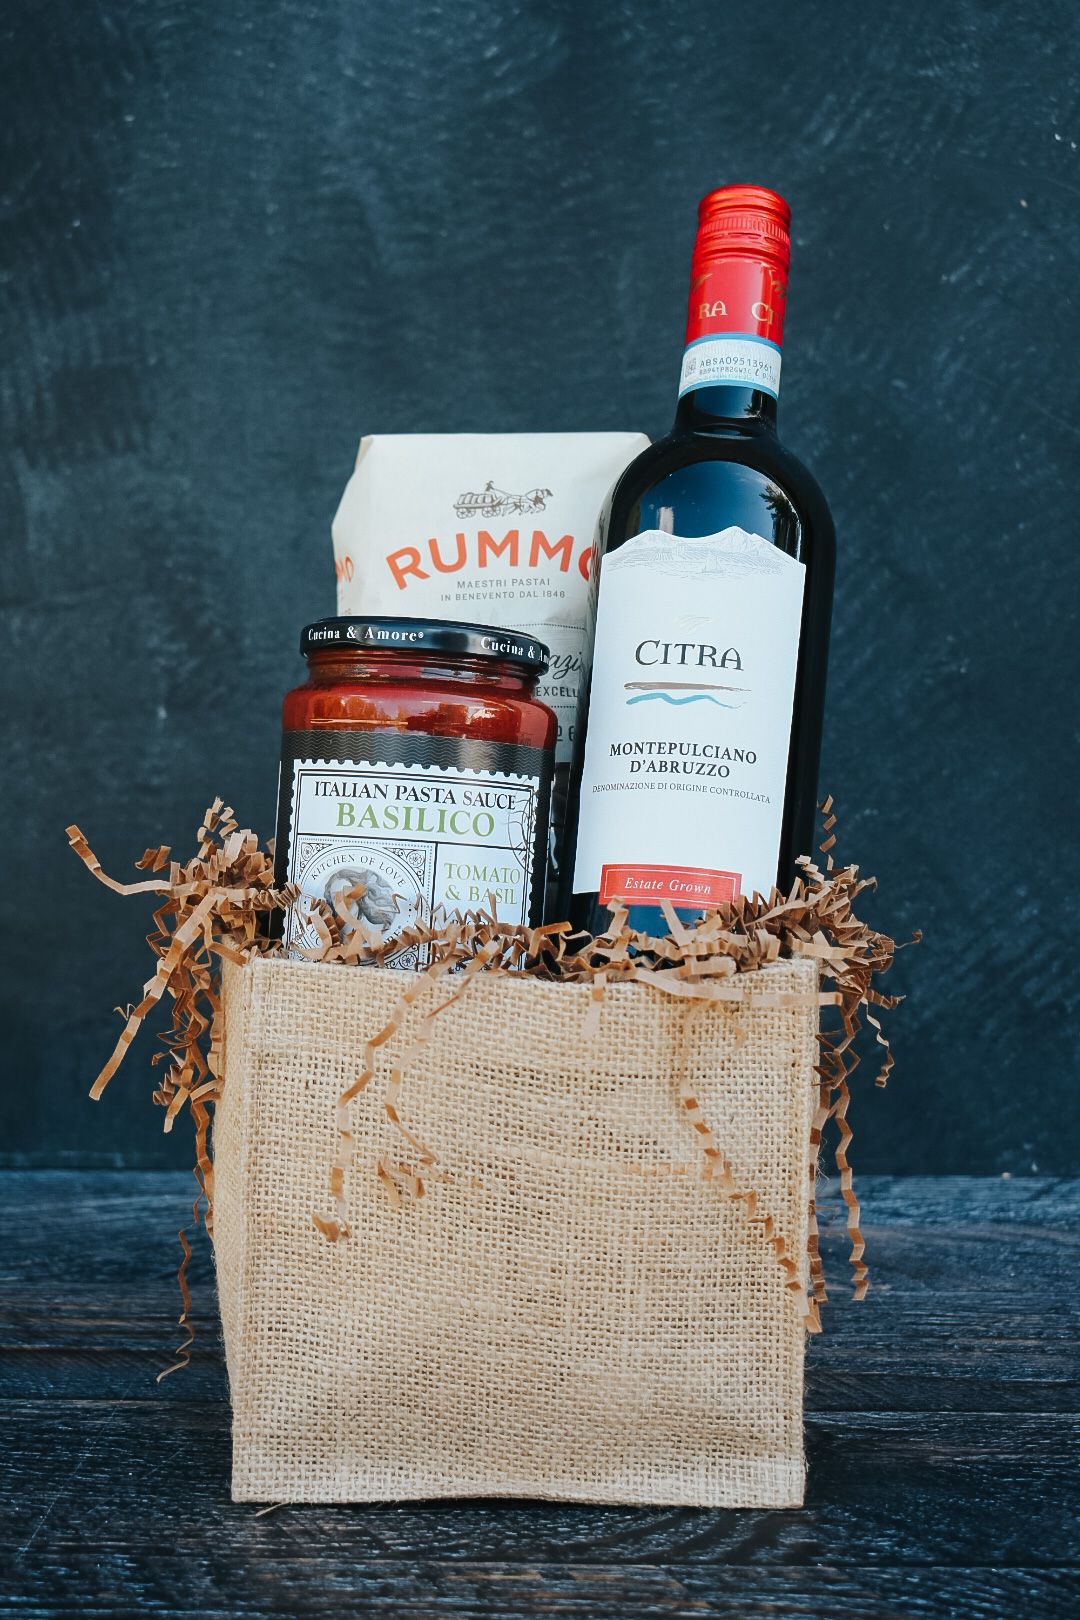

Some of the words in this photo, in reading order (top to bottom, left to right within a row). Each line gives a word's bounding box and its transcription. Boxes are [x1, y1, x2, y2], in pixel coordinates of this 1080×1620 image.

[457, 578, 507, 589] MAESTRI
[511, 578, 551, 587] PASTAI
[440, 594, 451, 602] IN
[455, 591, 516, 601] BENEVENTO
[519, 590, 538, 599] DAL
[308, 626, 341, 641] Cucina
[346, 626, 357, 639] &
[480, 636, 524, 656] Cucina
[527, 646, 536, 659] &
[635, 639, 745, 672] CITRA
[609, 741, 758, 765] MONTEPULCIANO
[629, 759, 731, 779] D'ABRUZZO
[314, 780, 389, 800] ITALIAN
[394, 785, 457, 805] PASTA
[462, 790, 517, 811] SAUCE
[592, 782, 656, 794] DENOMINAZIONE
[657, 782, 668, 790] DI
[669, 782, 708, 793] ORIGINE
[709, 786, 771, 804] CONTROLLATA
[336, 802, 496, 838] BASILICO
[311, 854, 355, 881] KITCHEN
[360, 855, 376, 866] OF
[379, 862, 407, 888] LOVE
[444, 862, 521, 885] TOMATO
[445, 884, 462, 901] &
[468, 885, 518, 905] BASIL
[624, 877, 664, 890] Estate
[669, 879, 712, 895] Grown
